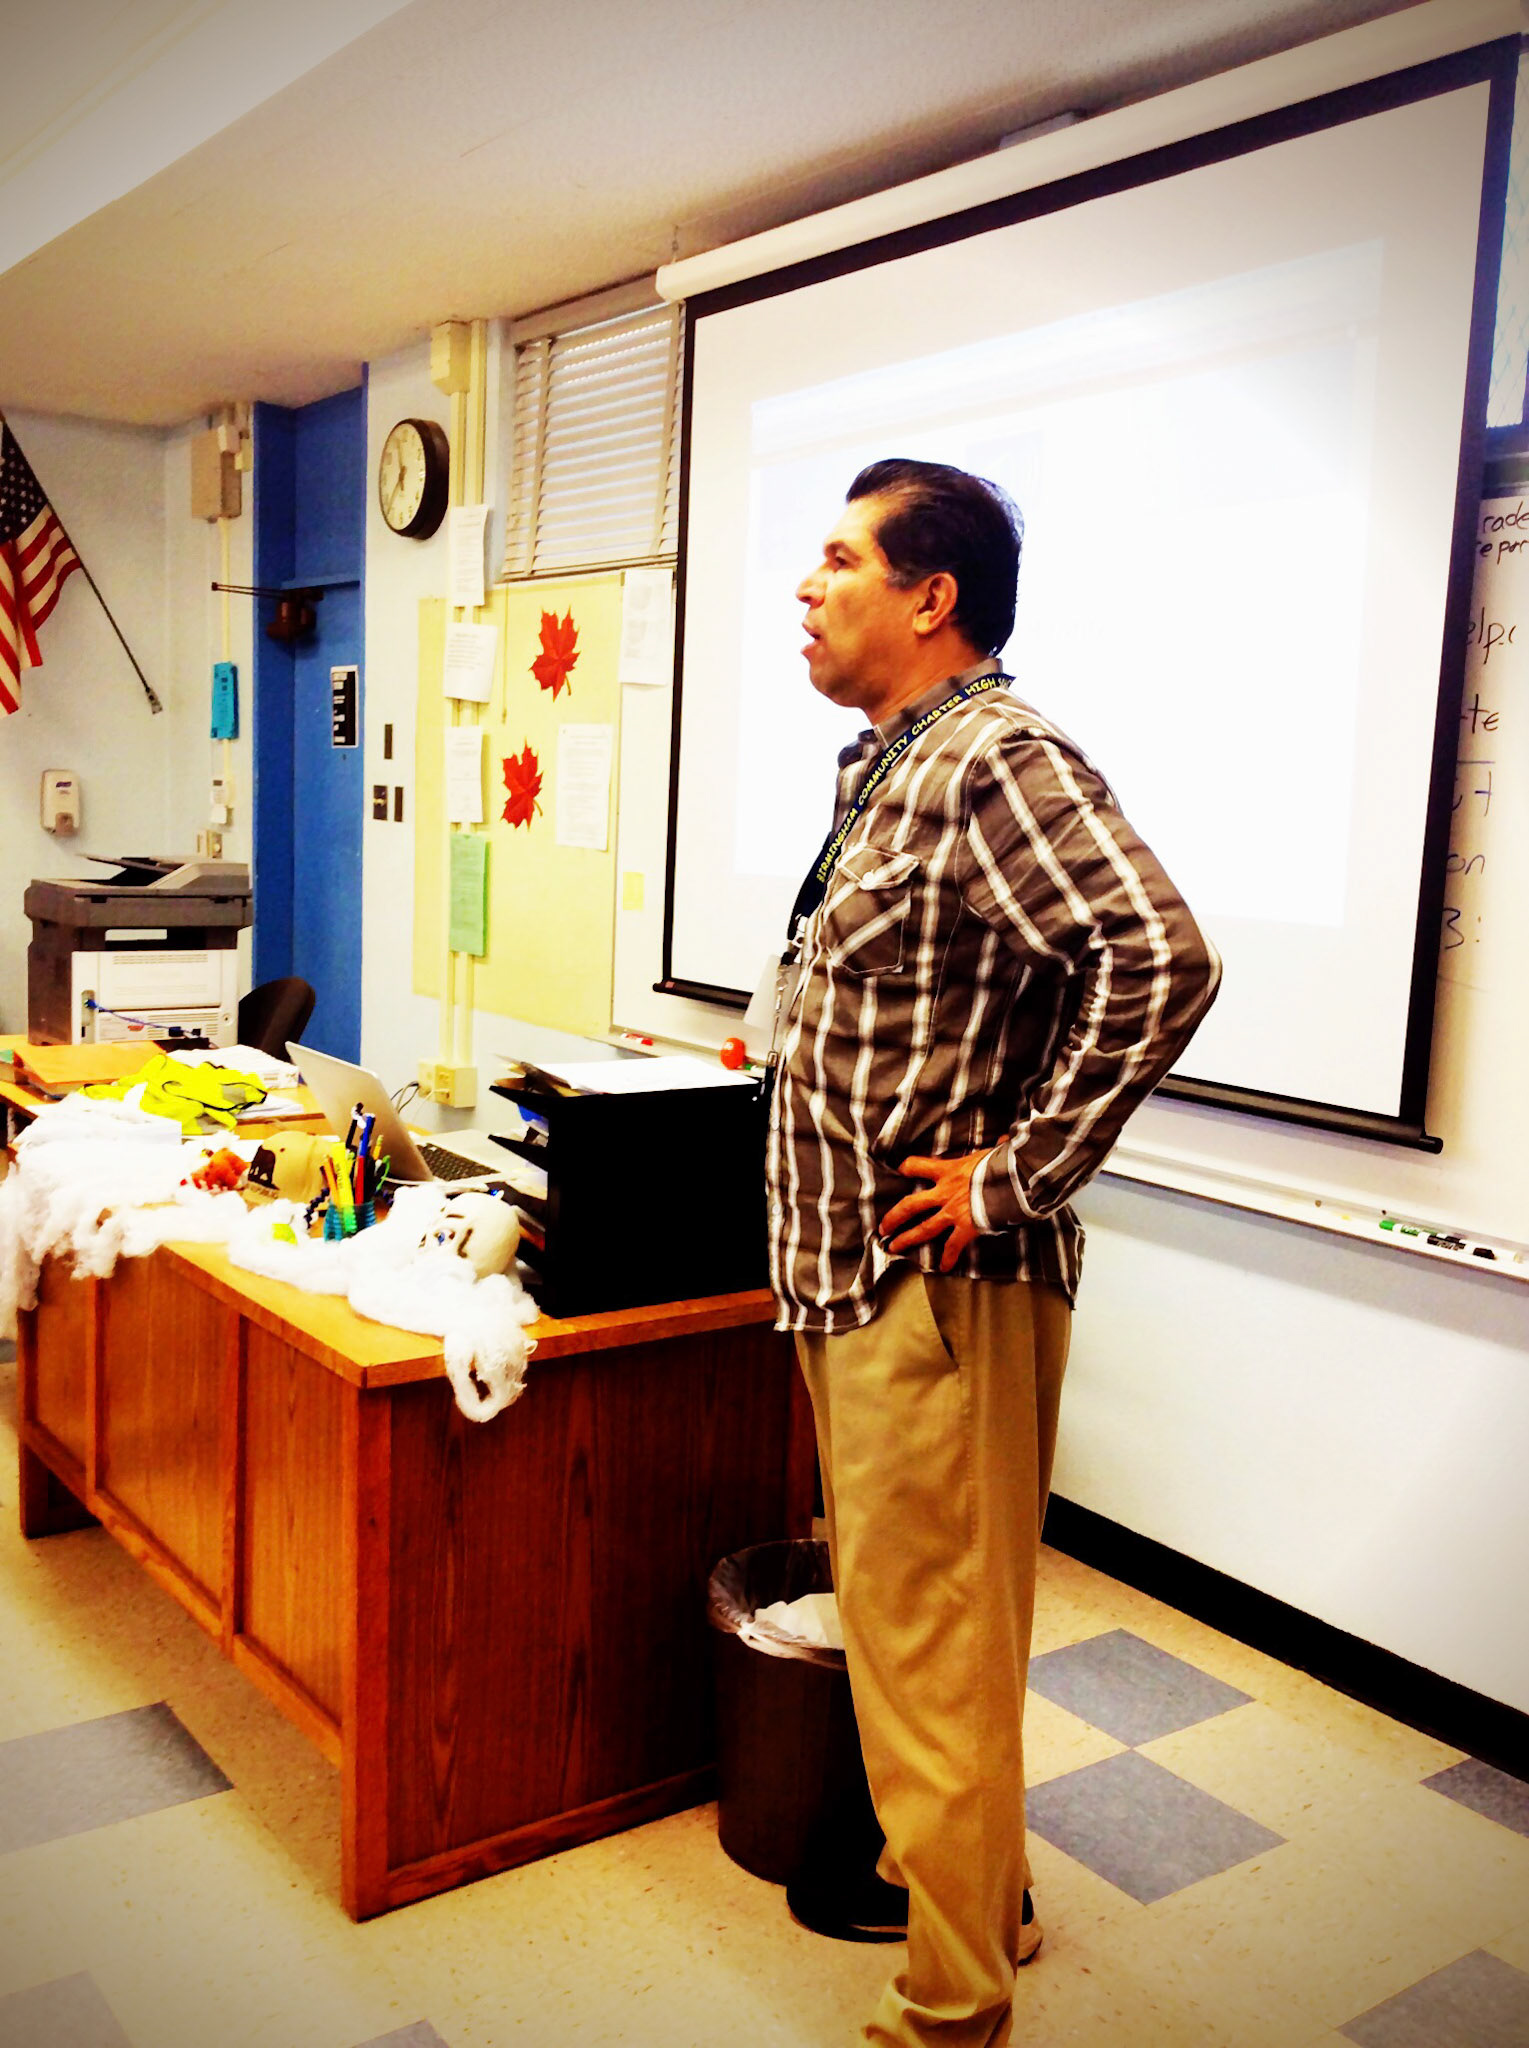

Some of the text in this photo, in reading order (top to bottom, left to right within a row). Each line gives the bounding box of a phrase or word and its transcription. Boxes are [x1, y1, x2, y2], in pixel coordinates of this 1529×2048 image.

[816, 808, 859, 883] BIRMINGHAM
[858, 735, 909, 806] COMMUNITY
[911, 694, 963, 735] CHARTER
[965, 677, 998, 696] HIGH
